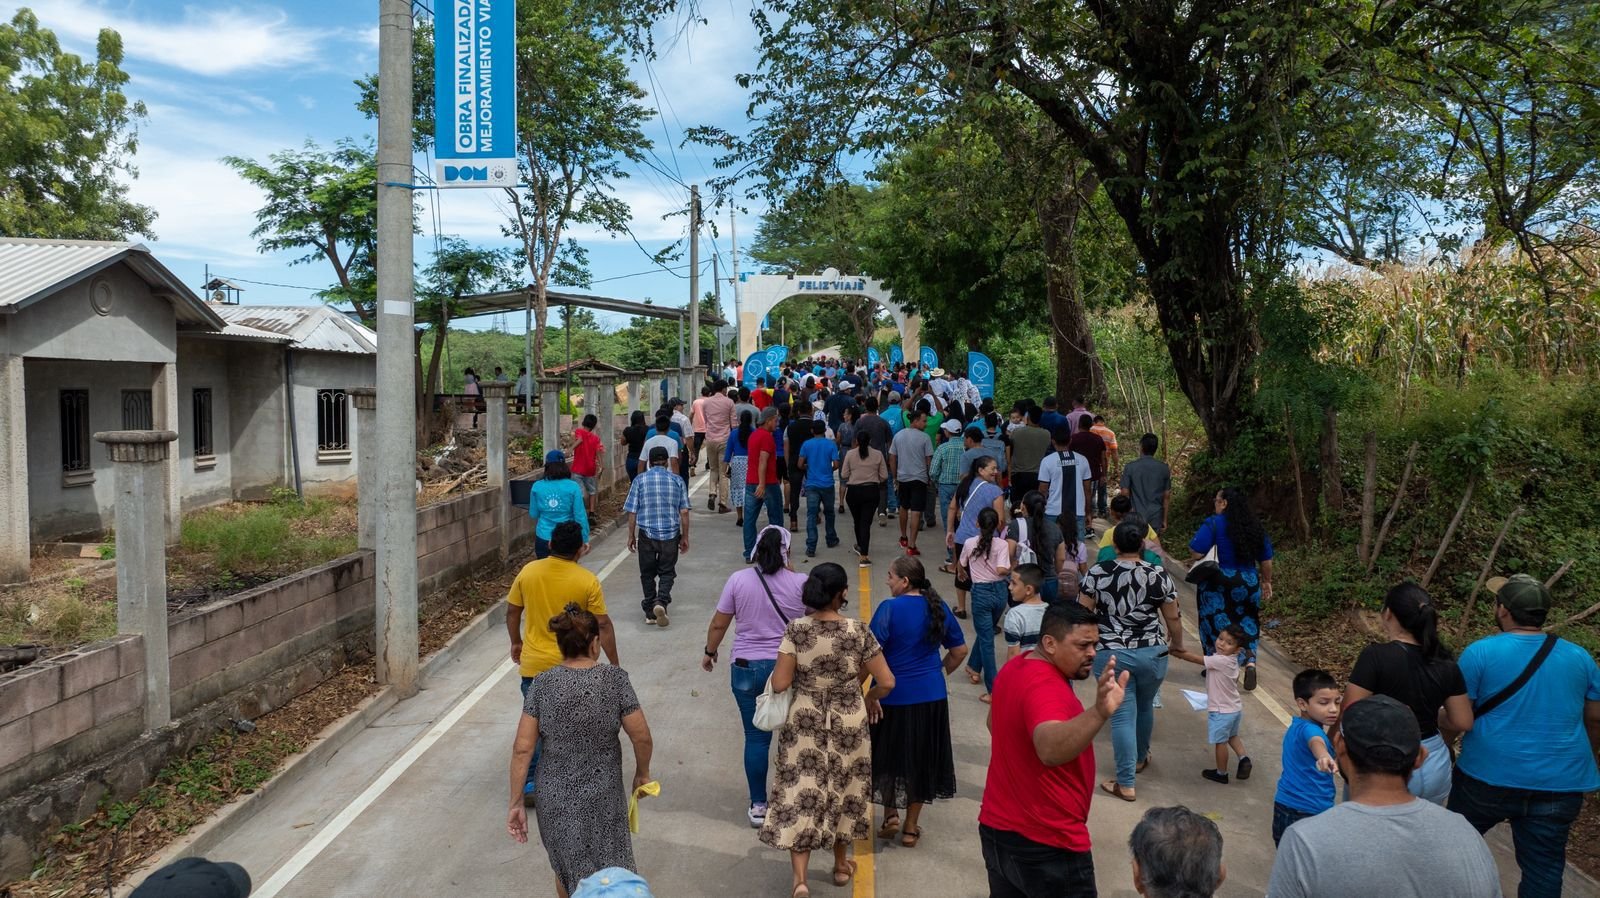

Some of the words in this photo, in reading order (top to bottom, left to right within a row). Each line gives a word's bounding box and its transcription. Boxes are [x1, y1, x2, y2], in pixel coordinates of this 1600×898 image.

[479, 27, 493, 152] MEJORAMIENTO
[459, 100, 473, 148] OBRA
[444, 166, 488, 181] DOM
[799, 281, 829, 290] FELIZ
[833, 281, 864, 291] VIAJE
